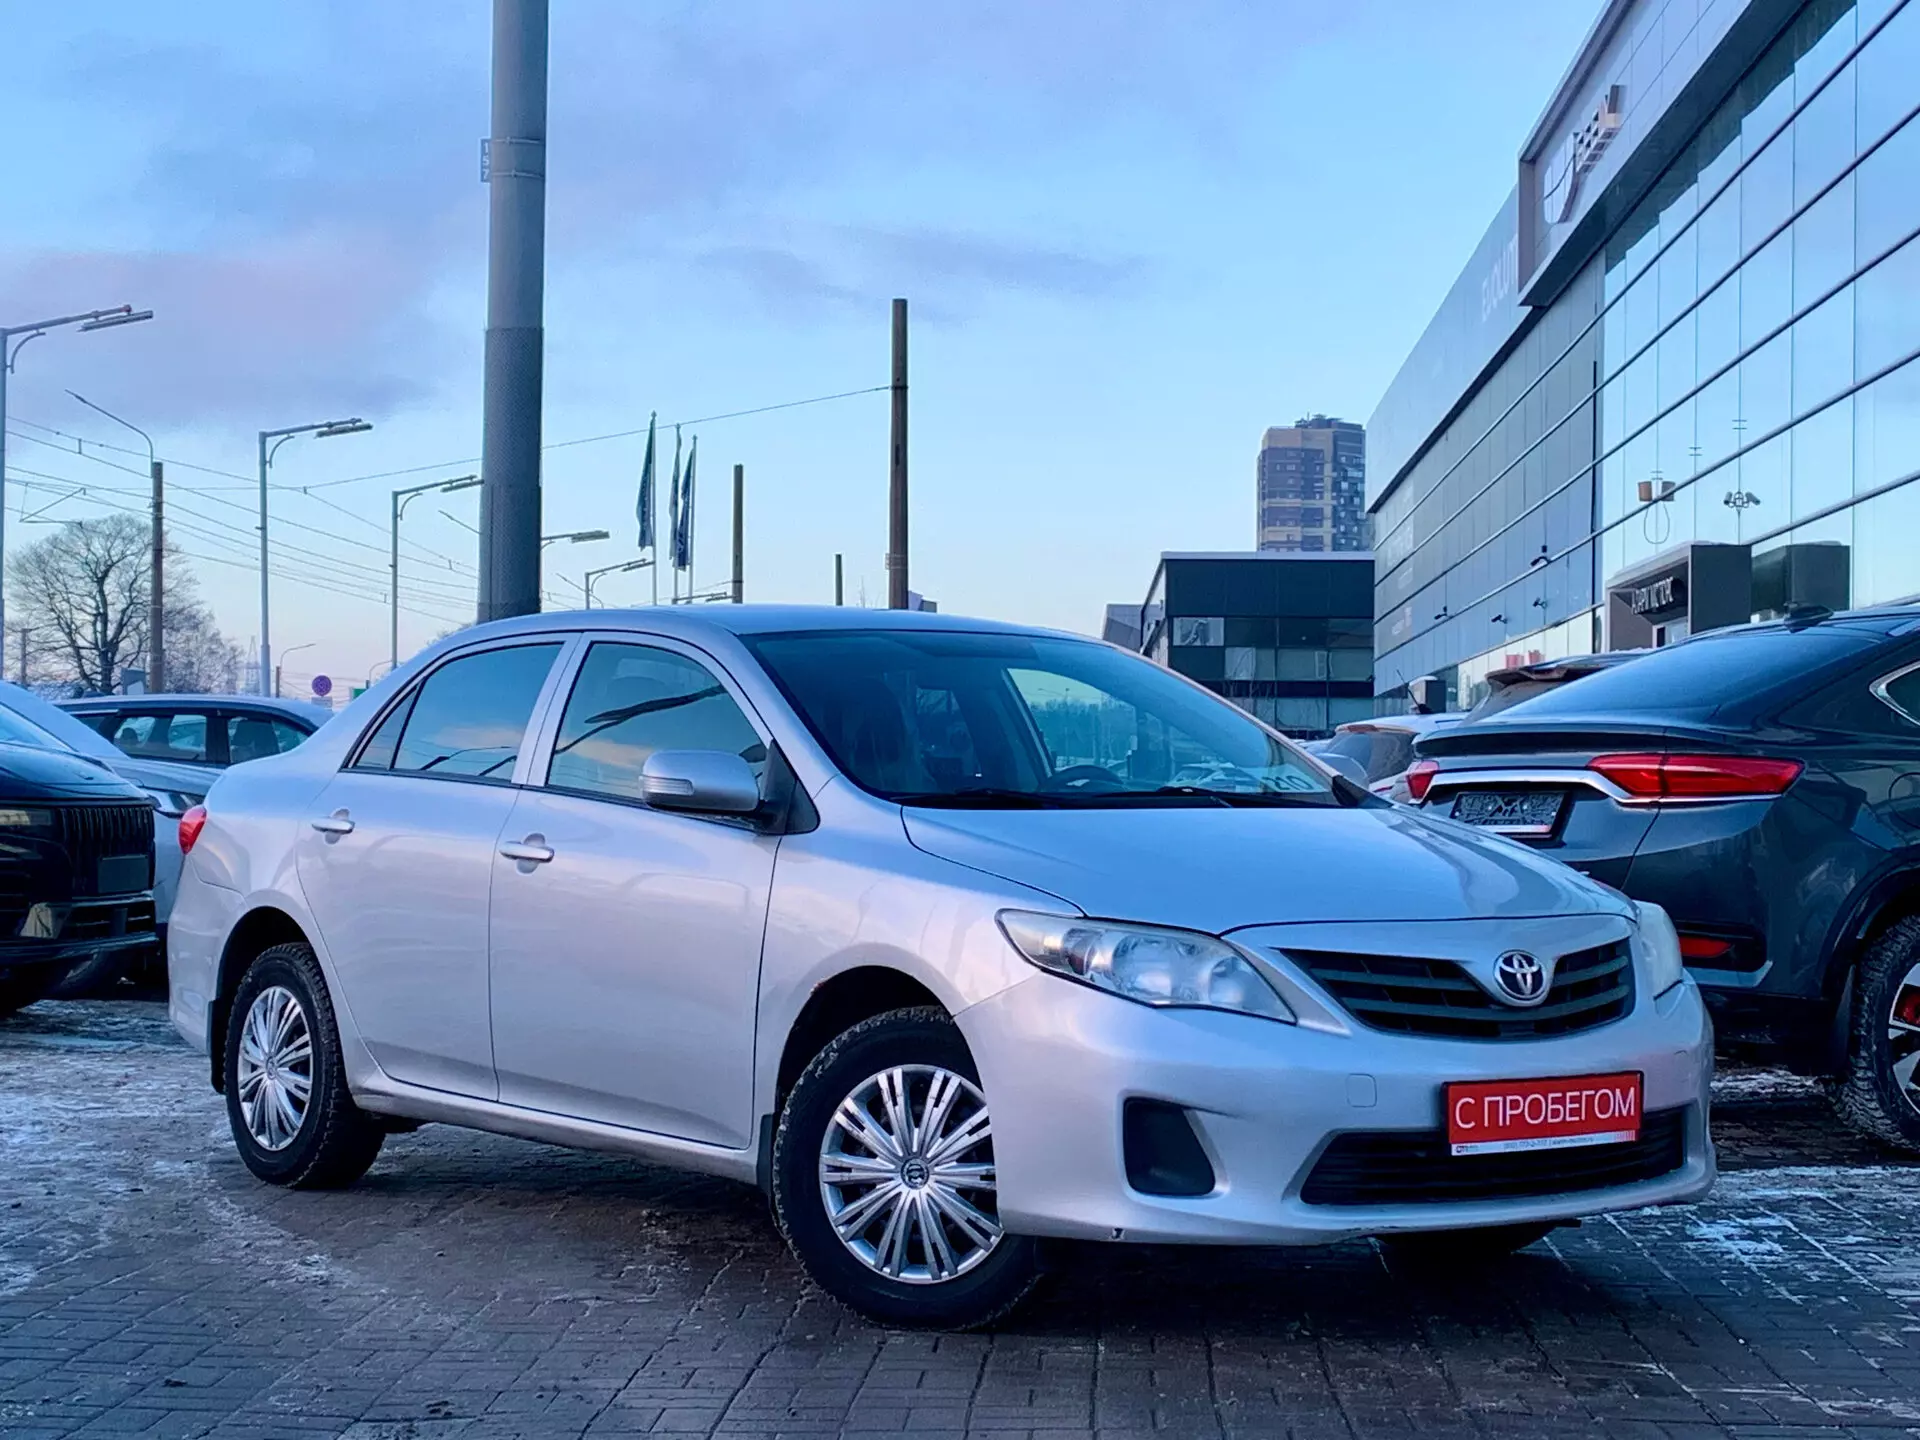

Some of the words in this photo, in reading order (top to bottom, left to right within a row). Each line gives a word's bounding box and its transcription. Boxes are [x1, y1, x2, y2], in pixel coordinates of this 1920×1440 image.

[482, 142, 490, 180] 157
[1455, 1097, 1475, 1129] С
[1484, 1087, 1635, 1127] ПРОБЕГОМ
